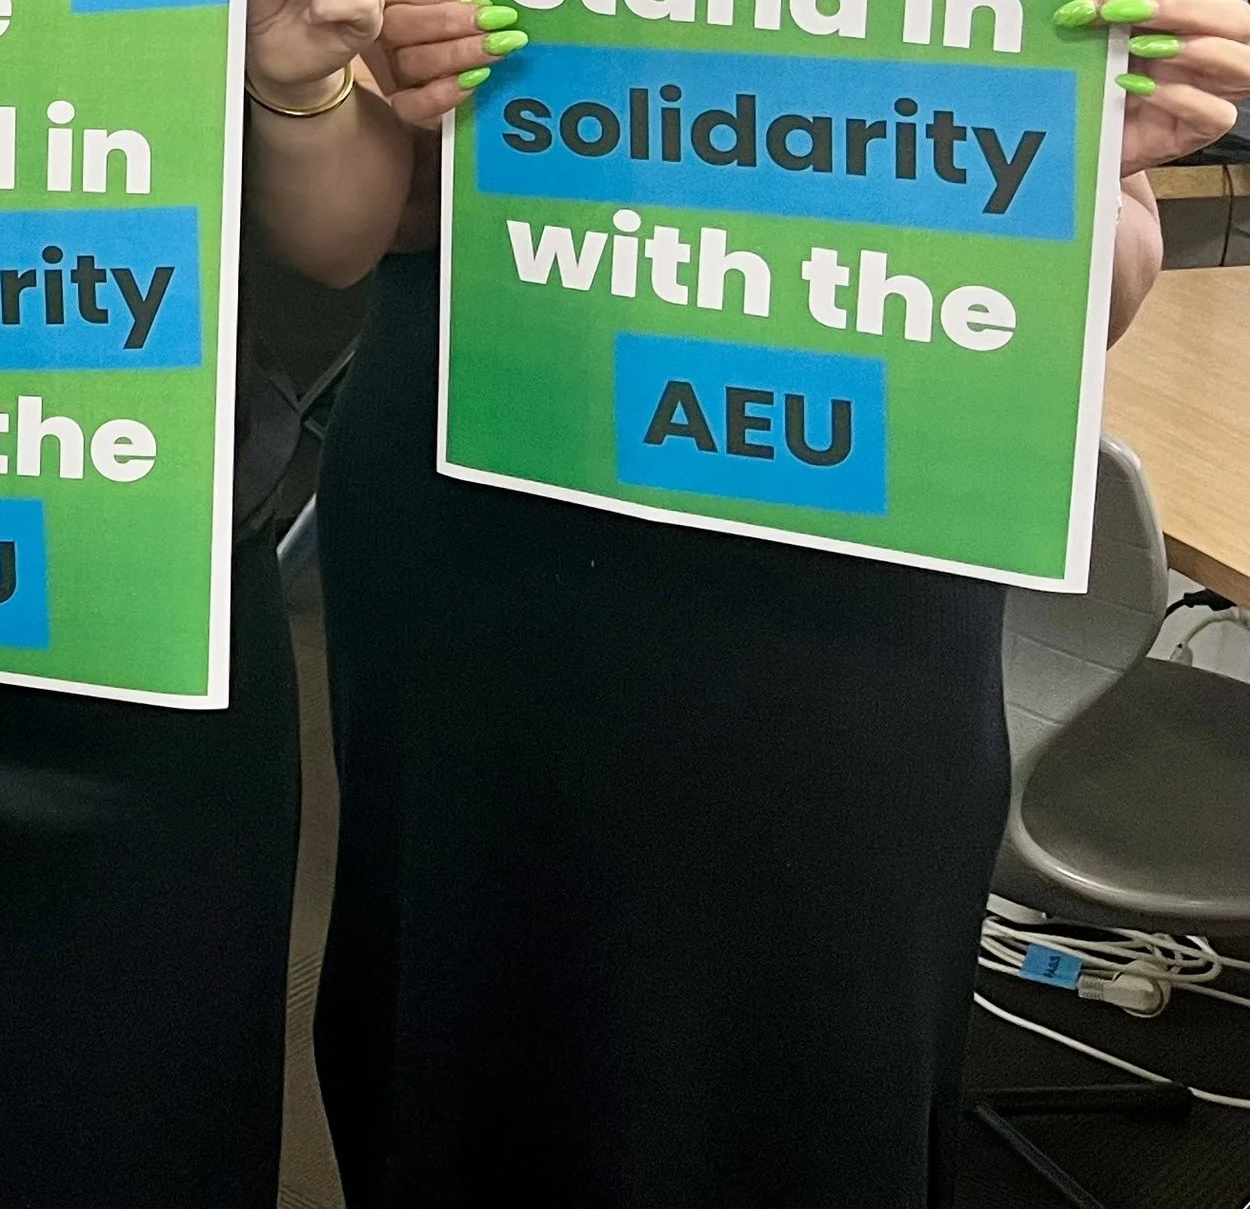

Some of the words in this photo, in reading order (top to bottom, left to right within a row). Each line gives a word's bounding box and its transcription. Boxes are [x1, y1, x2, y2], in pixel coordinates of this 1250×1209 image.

[46, 99, 151, 194] in
[501, 83, 1047, 215] solidarity
[505, 209, 772, 319] with
[801, 247, 1017, 352] the
[642, 378, 854, 466] AEU
